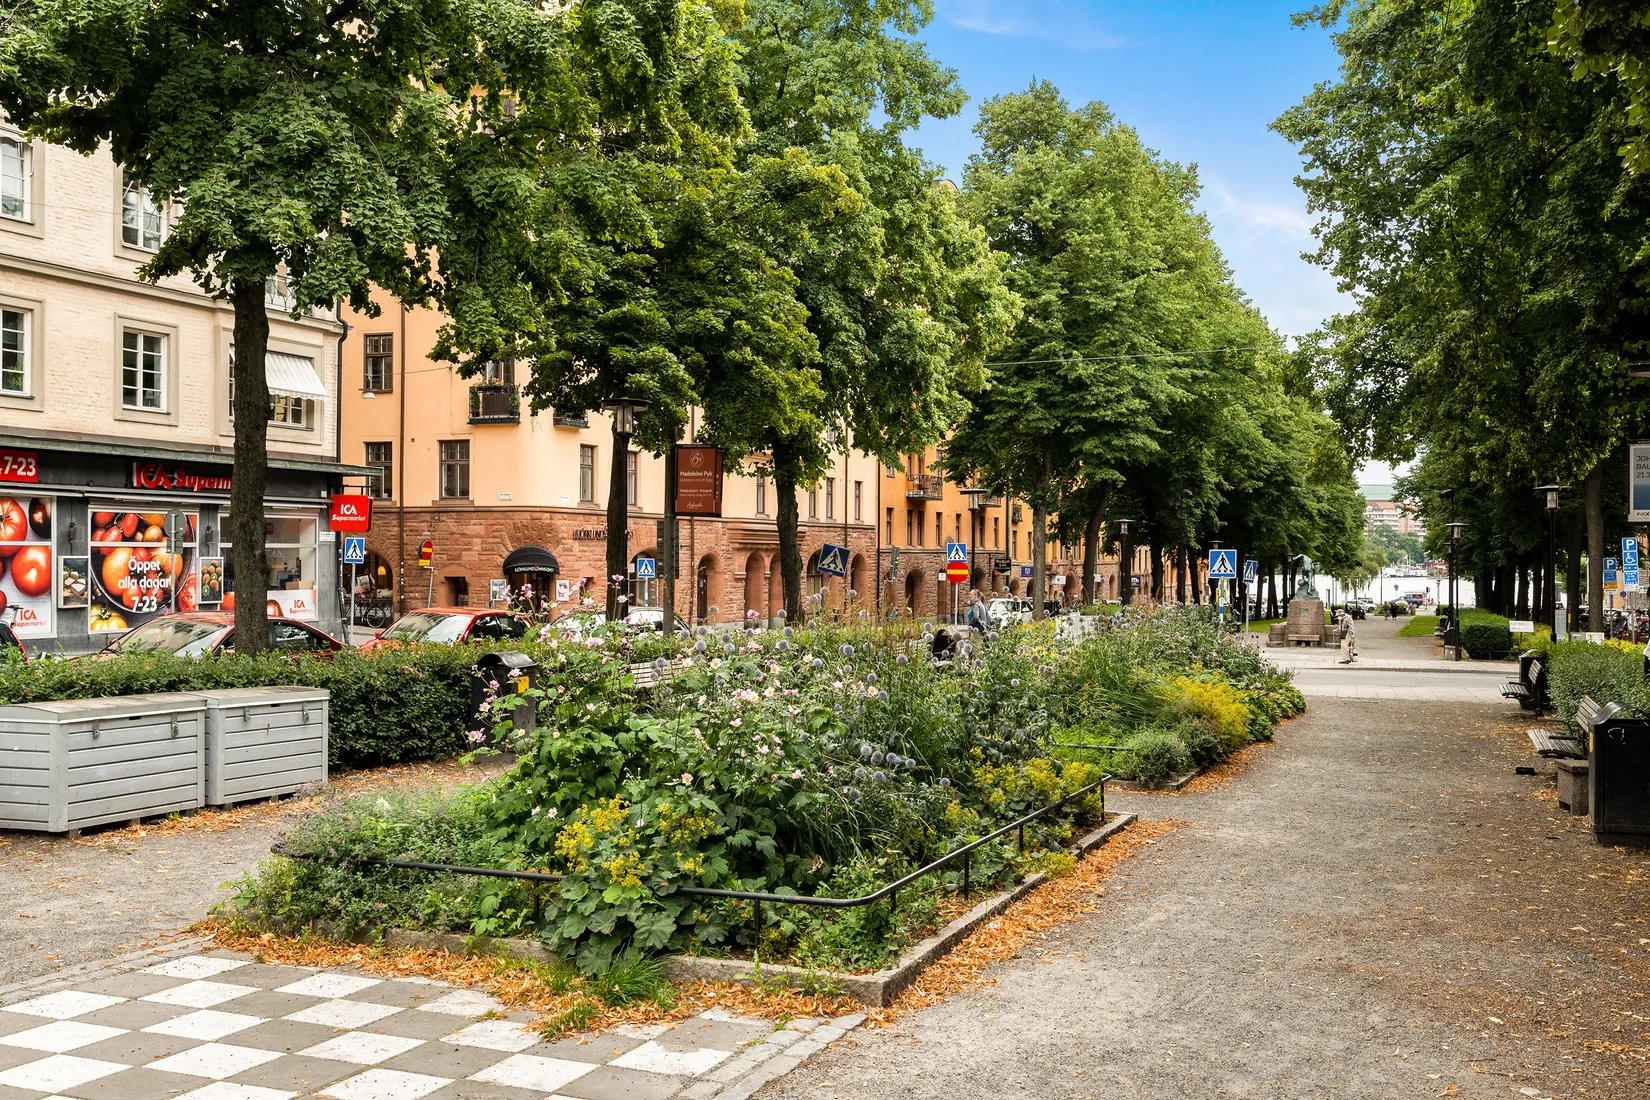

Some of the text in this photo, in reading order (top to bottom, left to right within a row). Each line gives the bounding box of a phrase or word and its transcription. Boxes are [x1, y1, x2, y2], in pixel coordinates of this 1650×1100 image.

[4, 456, 36, 476] 7-23
[132, 462, 232, 491] ICA Superm
[703, 470, 713, 478] Pyk
[340, 504, 357, 515] ICA
[332, 514, 366, 522] Supermarket
[1625, 539, 1635, 550] P
[128, 556, 161, 573] Öppet
[1606, 559, 1615, 569] P
[118, 576, 138, 589] alla
[131, 596, 158, 612] 7-23
[293, 599, 305, 609] ICA
[20, 609, 37, 620] ICA
[13, 620, 47, 628] Supermarket
